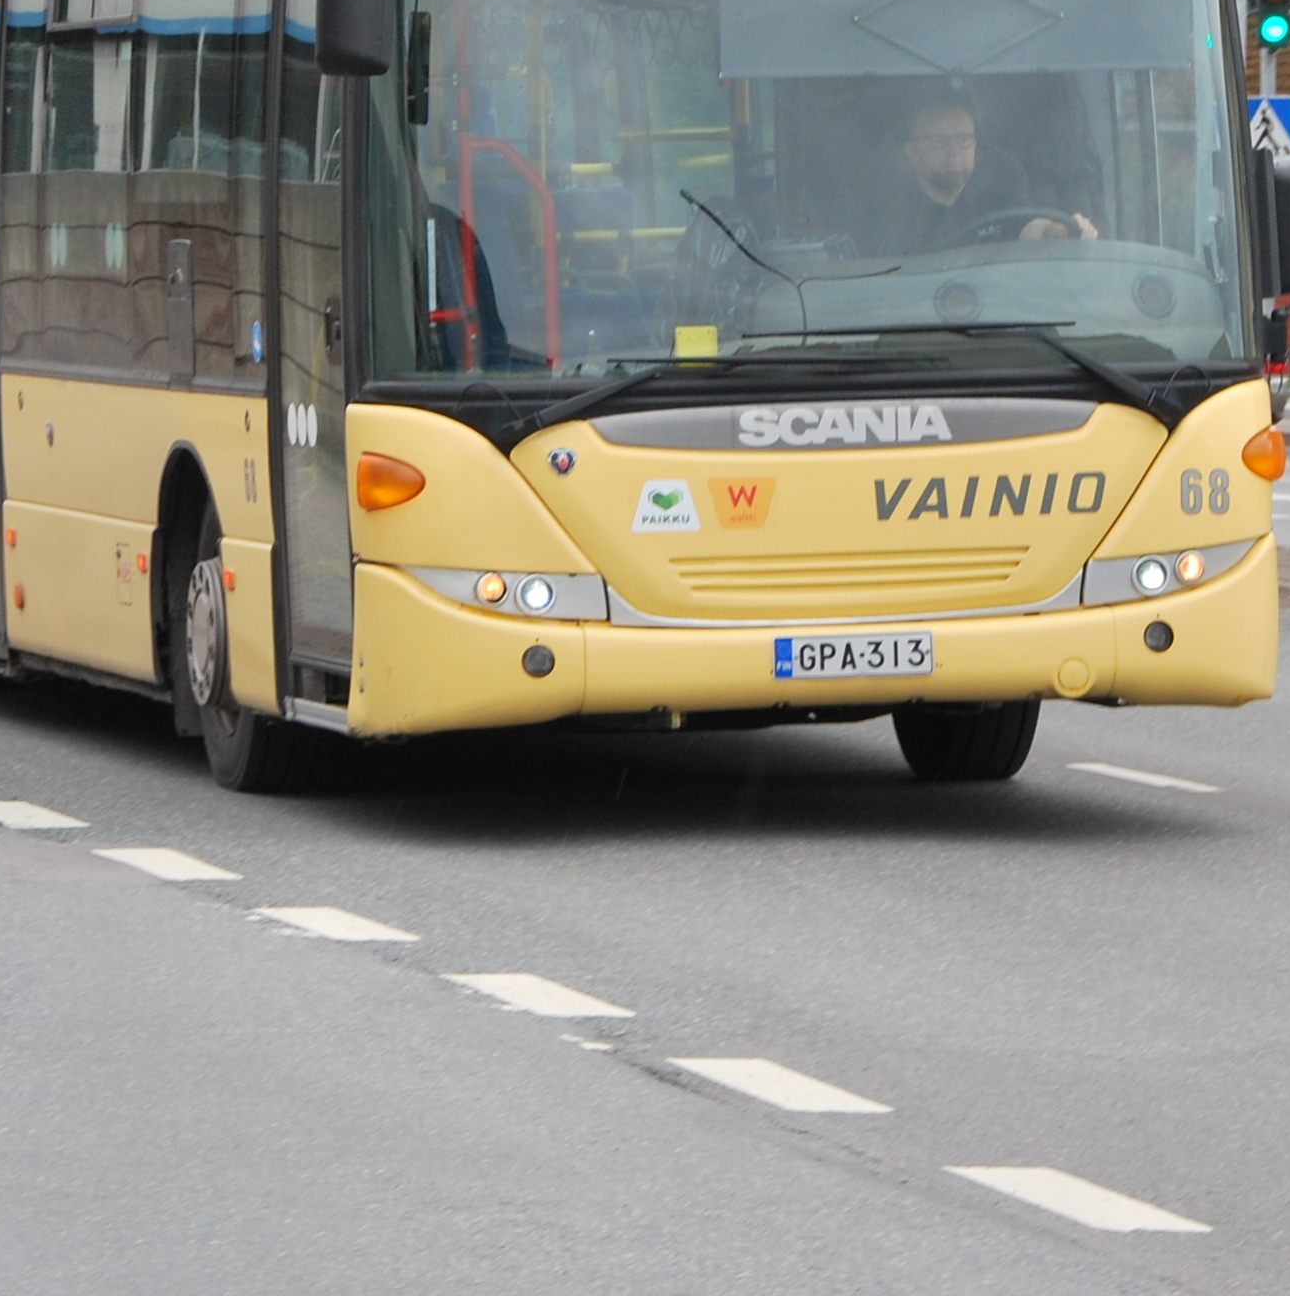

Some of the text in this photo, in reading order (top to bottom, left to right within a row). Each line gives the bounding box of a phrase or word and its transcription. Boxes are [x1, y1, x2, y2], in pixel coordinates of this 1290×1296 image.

[738, 406, 952, 447] SCANIA
[727, 484, 758, 508] W
[873, 471, 1106, 522] VAINIO
[1180, 468, 1230, 515] 68
[642, 515, 690, 524] PAIKKU
[799, 638, 926, 671] GPA-313
